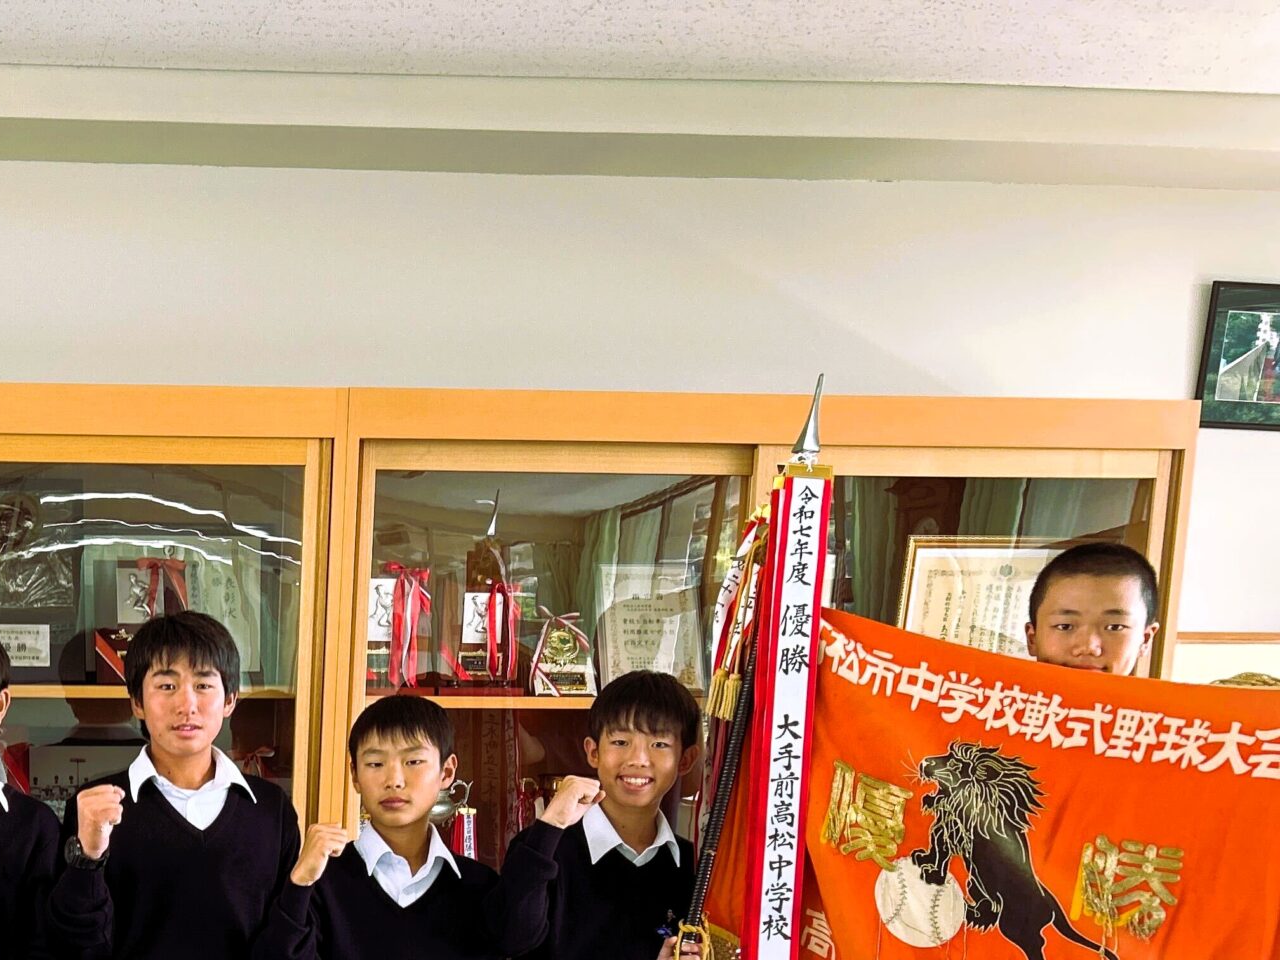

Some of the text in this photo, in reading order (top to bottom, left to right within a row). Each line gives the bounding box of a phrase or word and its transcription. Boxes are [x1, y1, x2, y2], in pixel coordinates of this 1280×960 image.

[761, 485, 819, 942] 令和七年度 優勝 大手前高松中学校
[821, 759, 914, 873] 優
[1070, 834, 1185, 943] 勝
